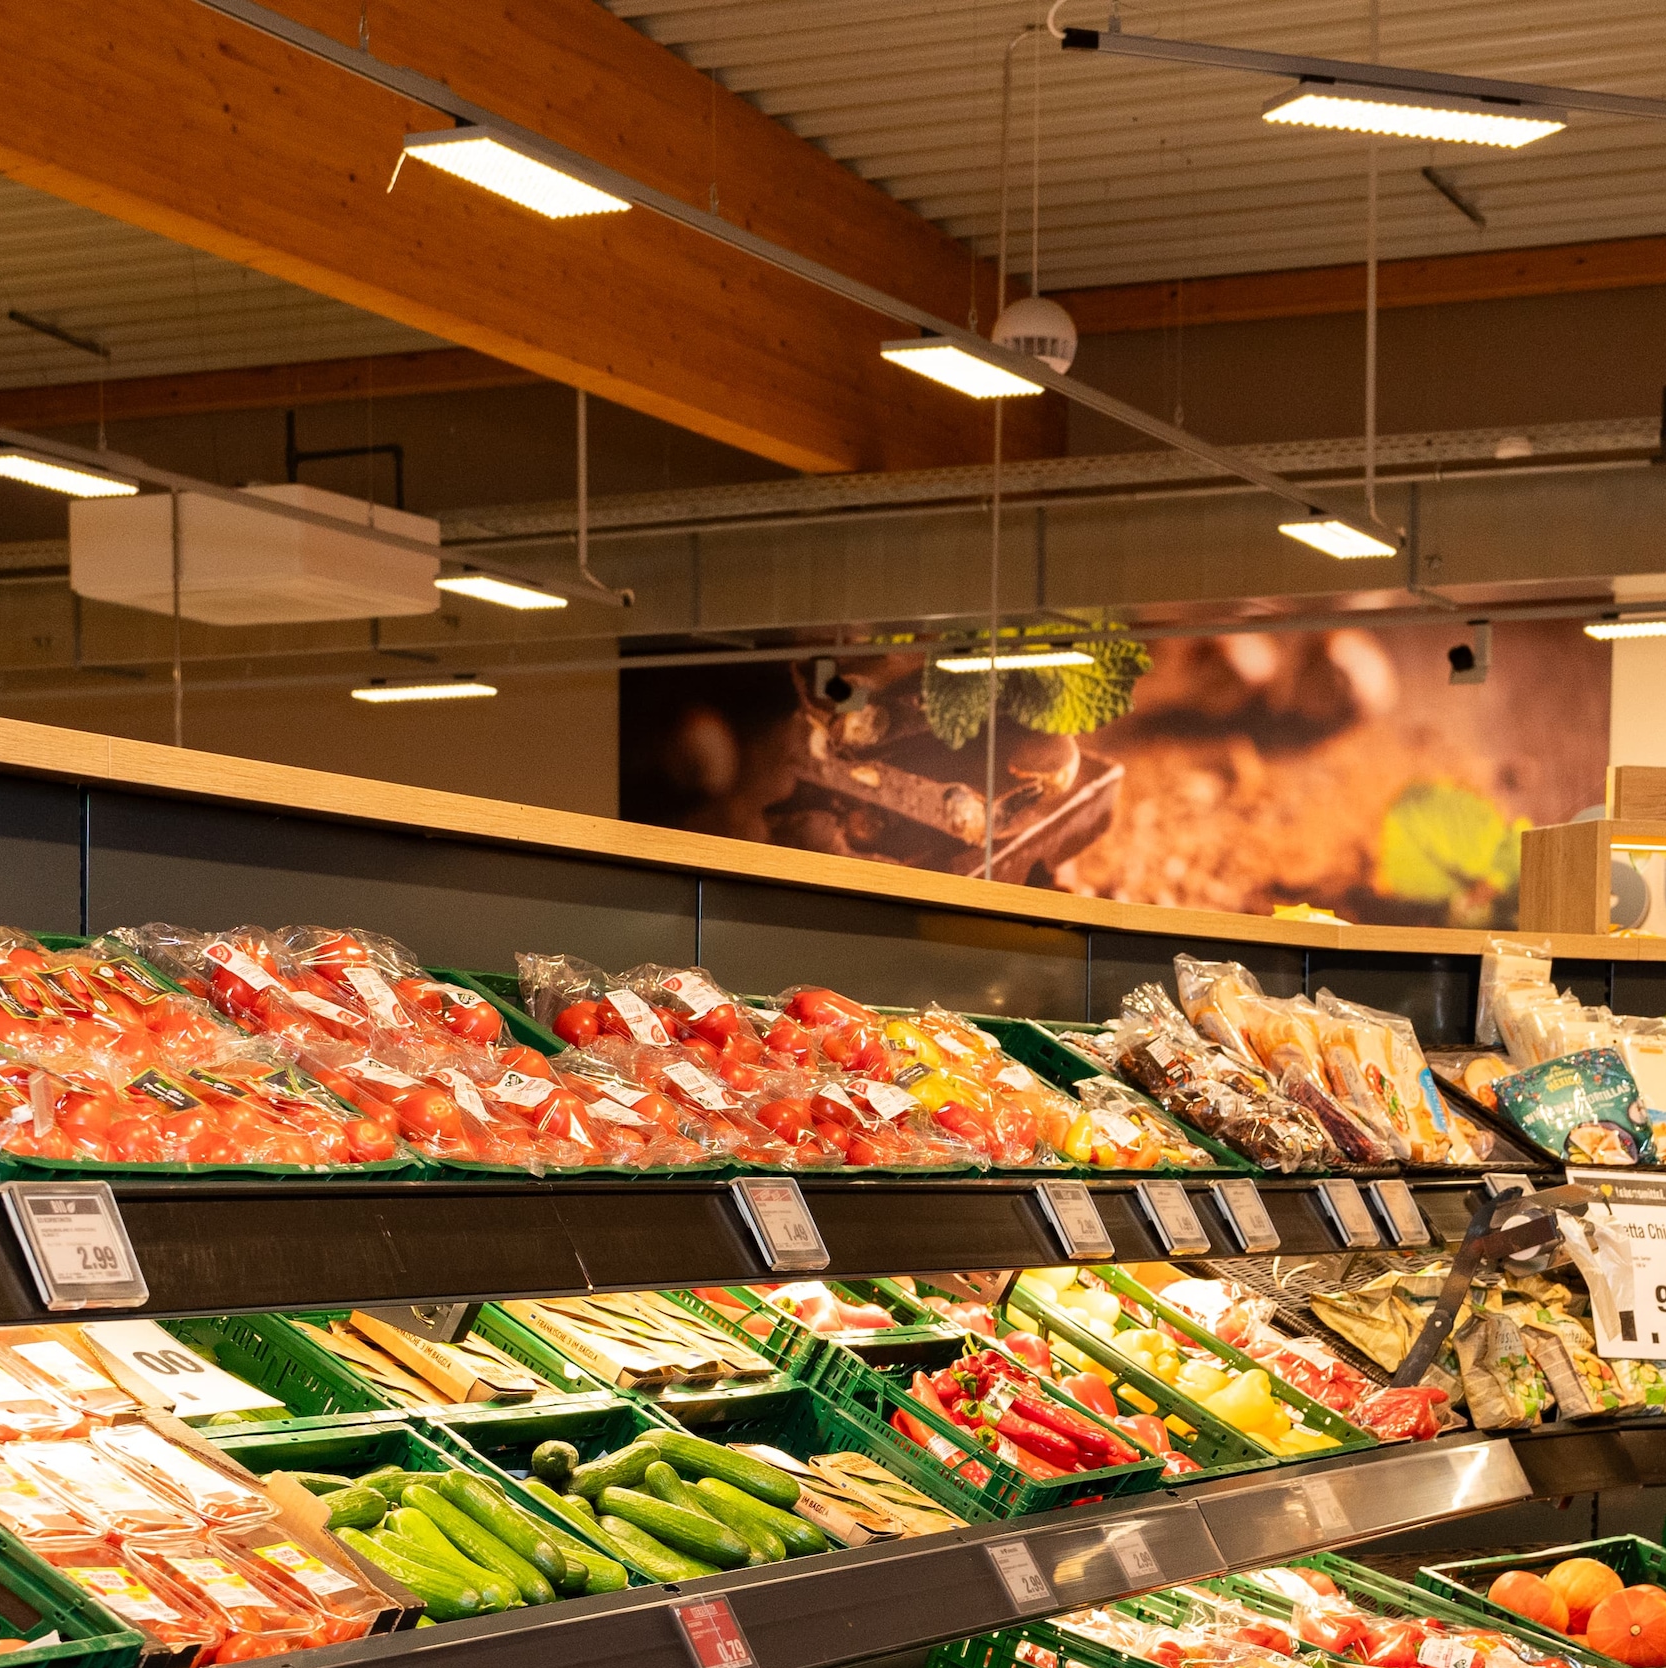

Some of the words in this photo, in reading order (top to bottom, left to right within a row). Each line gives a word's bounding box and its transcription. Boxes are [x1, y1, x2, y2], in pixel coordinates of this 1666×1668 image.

[783, 1223, 809, 1242] 1.49
[77, 1246, 118, 1270] 2.99
[133, 1349, 205, 1376] 00
[1022, 1575, 1045, 1593] 2.99
[716, 1639, 746, 1662] 0.79
